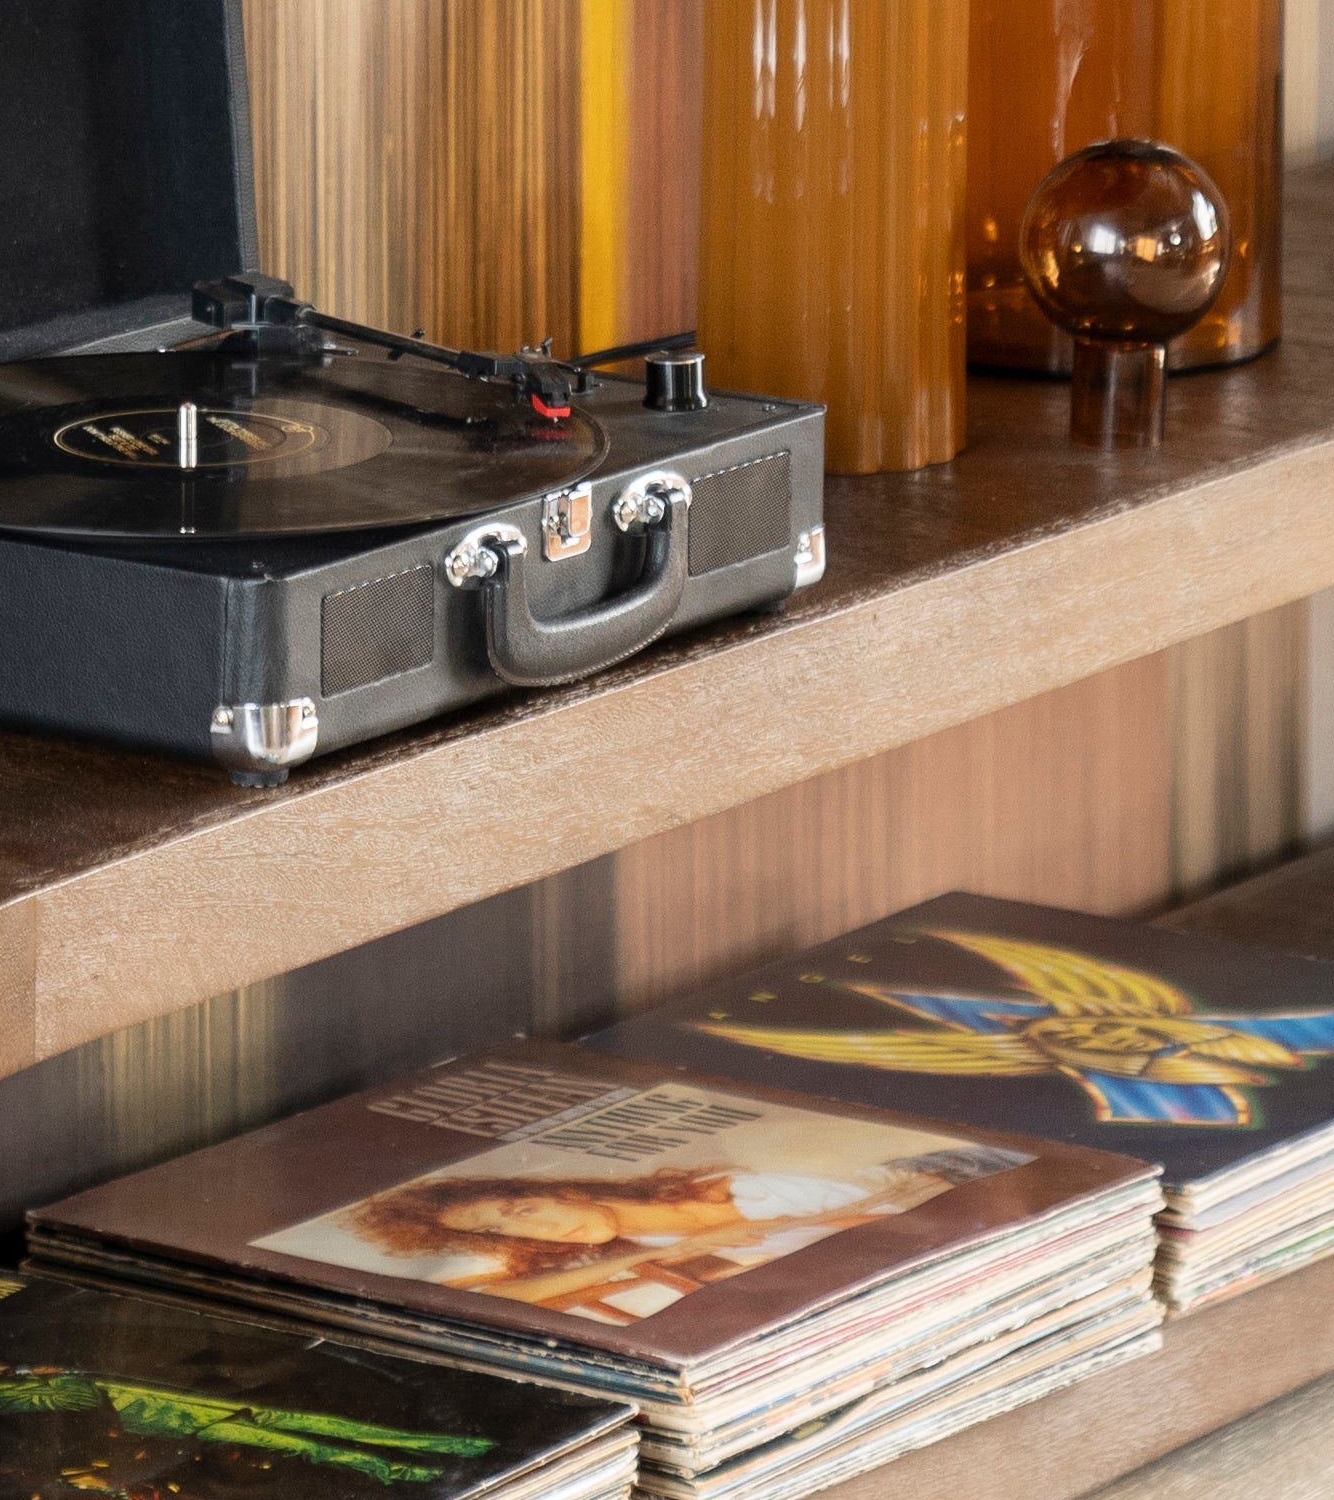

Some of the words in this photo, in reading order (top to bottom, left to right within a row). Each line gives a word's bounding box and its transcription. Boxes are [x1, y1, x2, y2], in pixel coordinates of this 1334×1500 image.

[366, 1061, 555, 1124] GLORIA
[429, 1074, 622, 1139] ESTEFAN
[529, 1093, 705, 1153] ANYTHING
[585, 1130, 690, 1163] FOR
[654, 1104, 764, 1136] YOU
